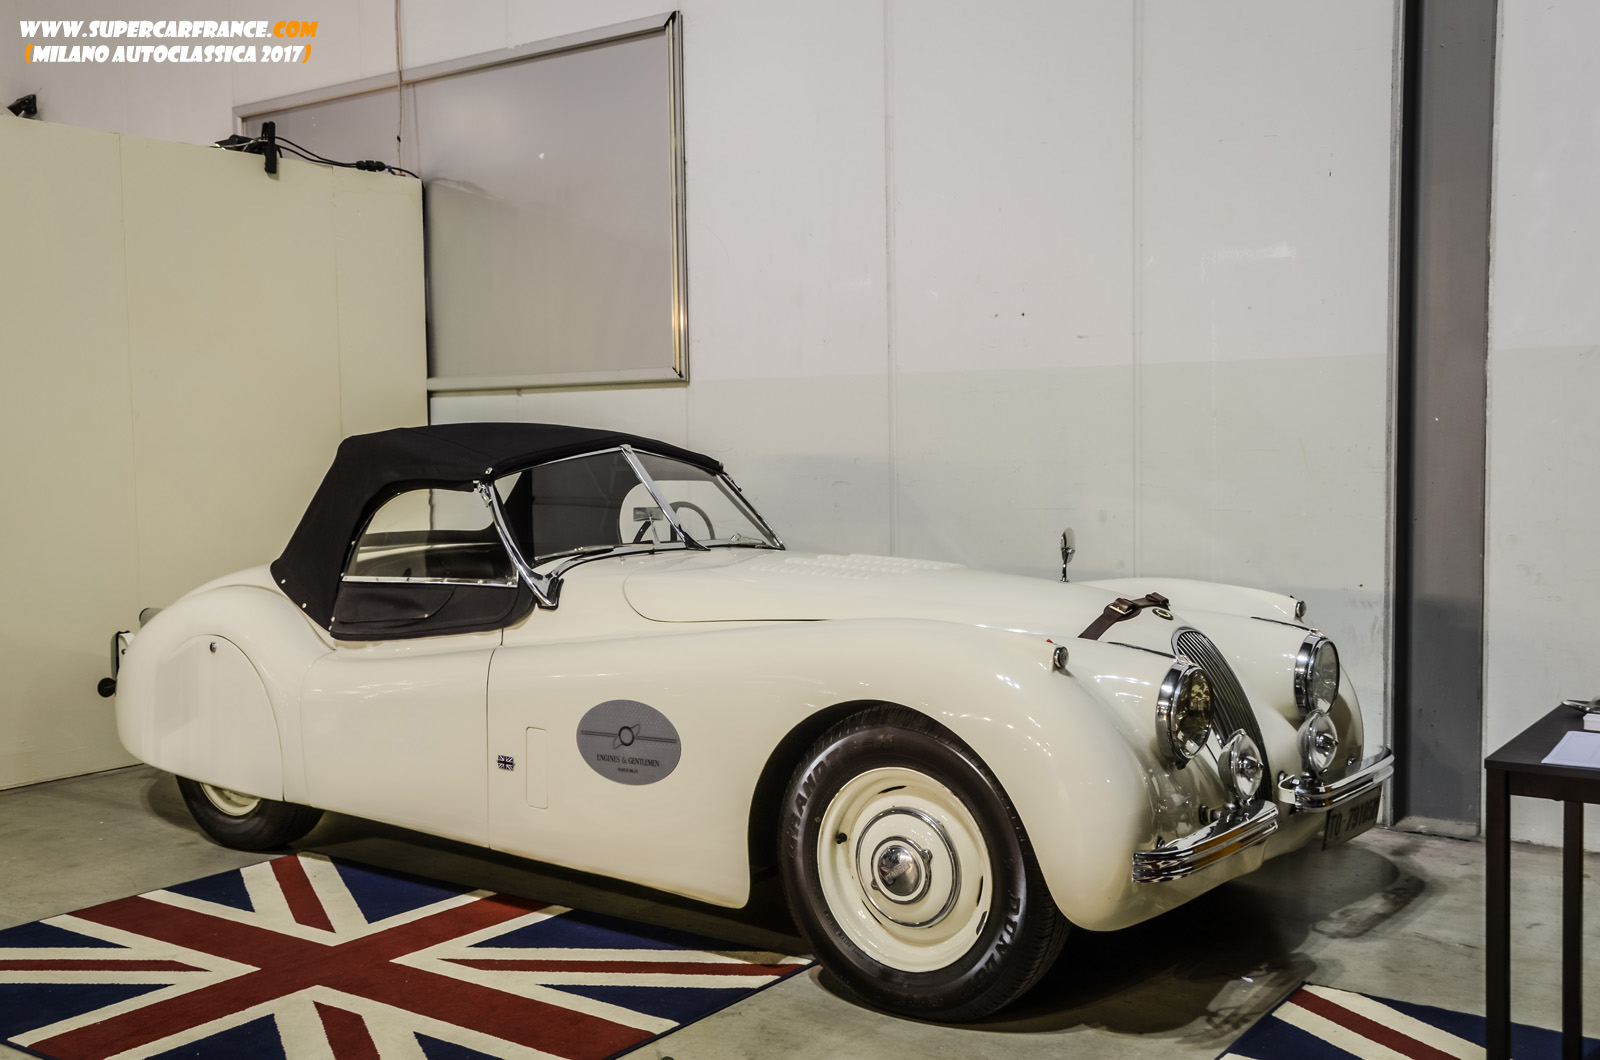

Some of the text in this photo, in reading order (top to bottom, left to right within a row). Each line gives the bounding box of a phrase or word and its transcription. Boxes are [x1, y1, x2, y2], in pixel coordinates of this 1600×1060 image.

[596, 754, 620, 763] ENGINES
[628, 757, 660, 767] GENTLEMEN
[956, 889, 1022, 997] DUNLOP
